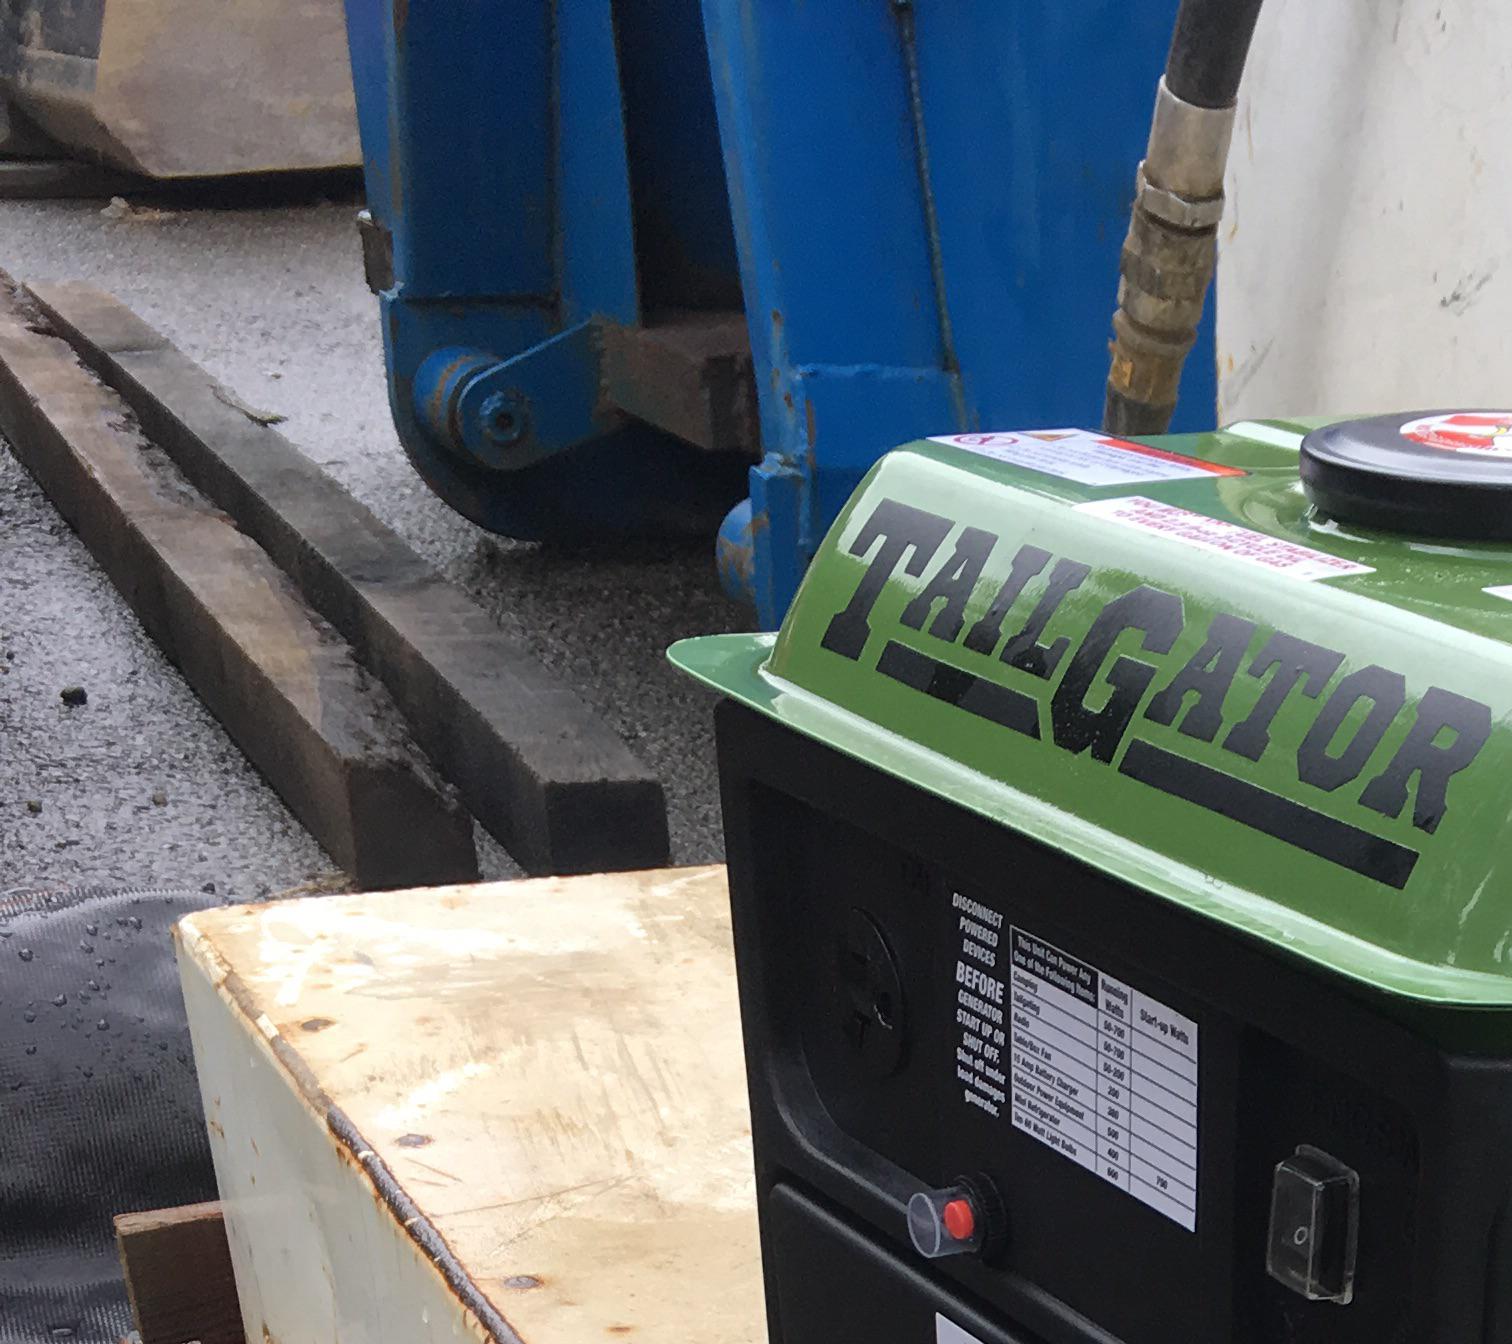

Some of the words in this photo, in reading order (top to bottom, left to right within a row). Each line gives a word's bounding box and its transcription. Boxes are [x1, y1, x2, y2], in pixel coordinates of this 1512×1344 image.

[820, 498, 1492, 834] TAILGATOR
[952, 892, 1003, 929] DISCONNECT
[959, 916, 998, 947] POWERED
[962, 938, 995, 967] DEVICES
[955, 960, 1004, 1004] BEFORE
[957, 988, 1002, 1024] GENERATOR
[956, 1008, 981, 1032] START
[981, 1021, 992, 1038] UP
[993, 1028, 1005, 1046] OR
[962, 1031, 983, 1053] SHUT
